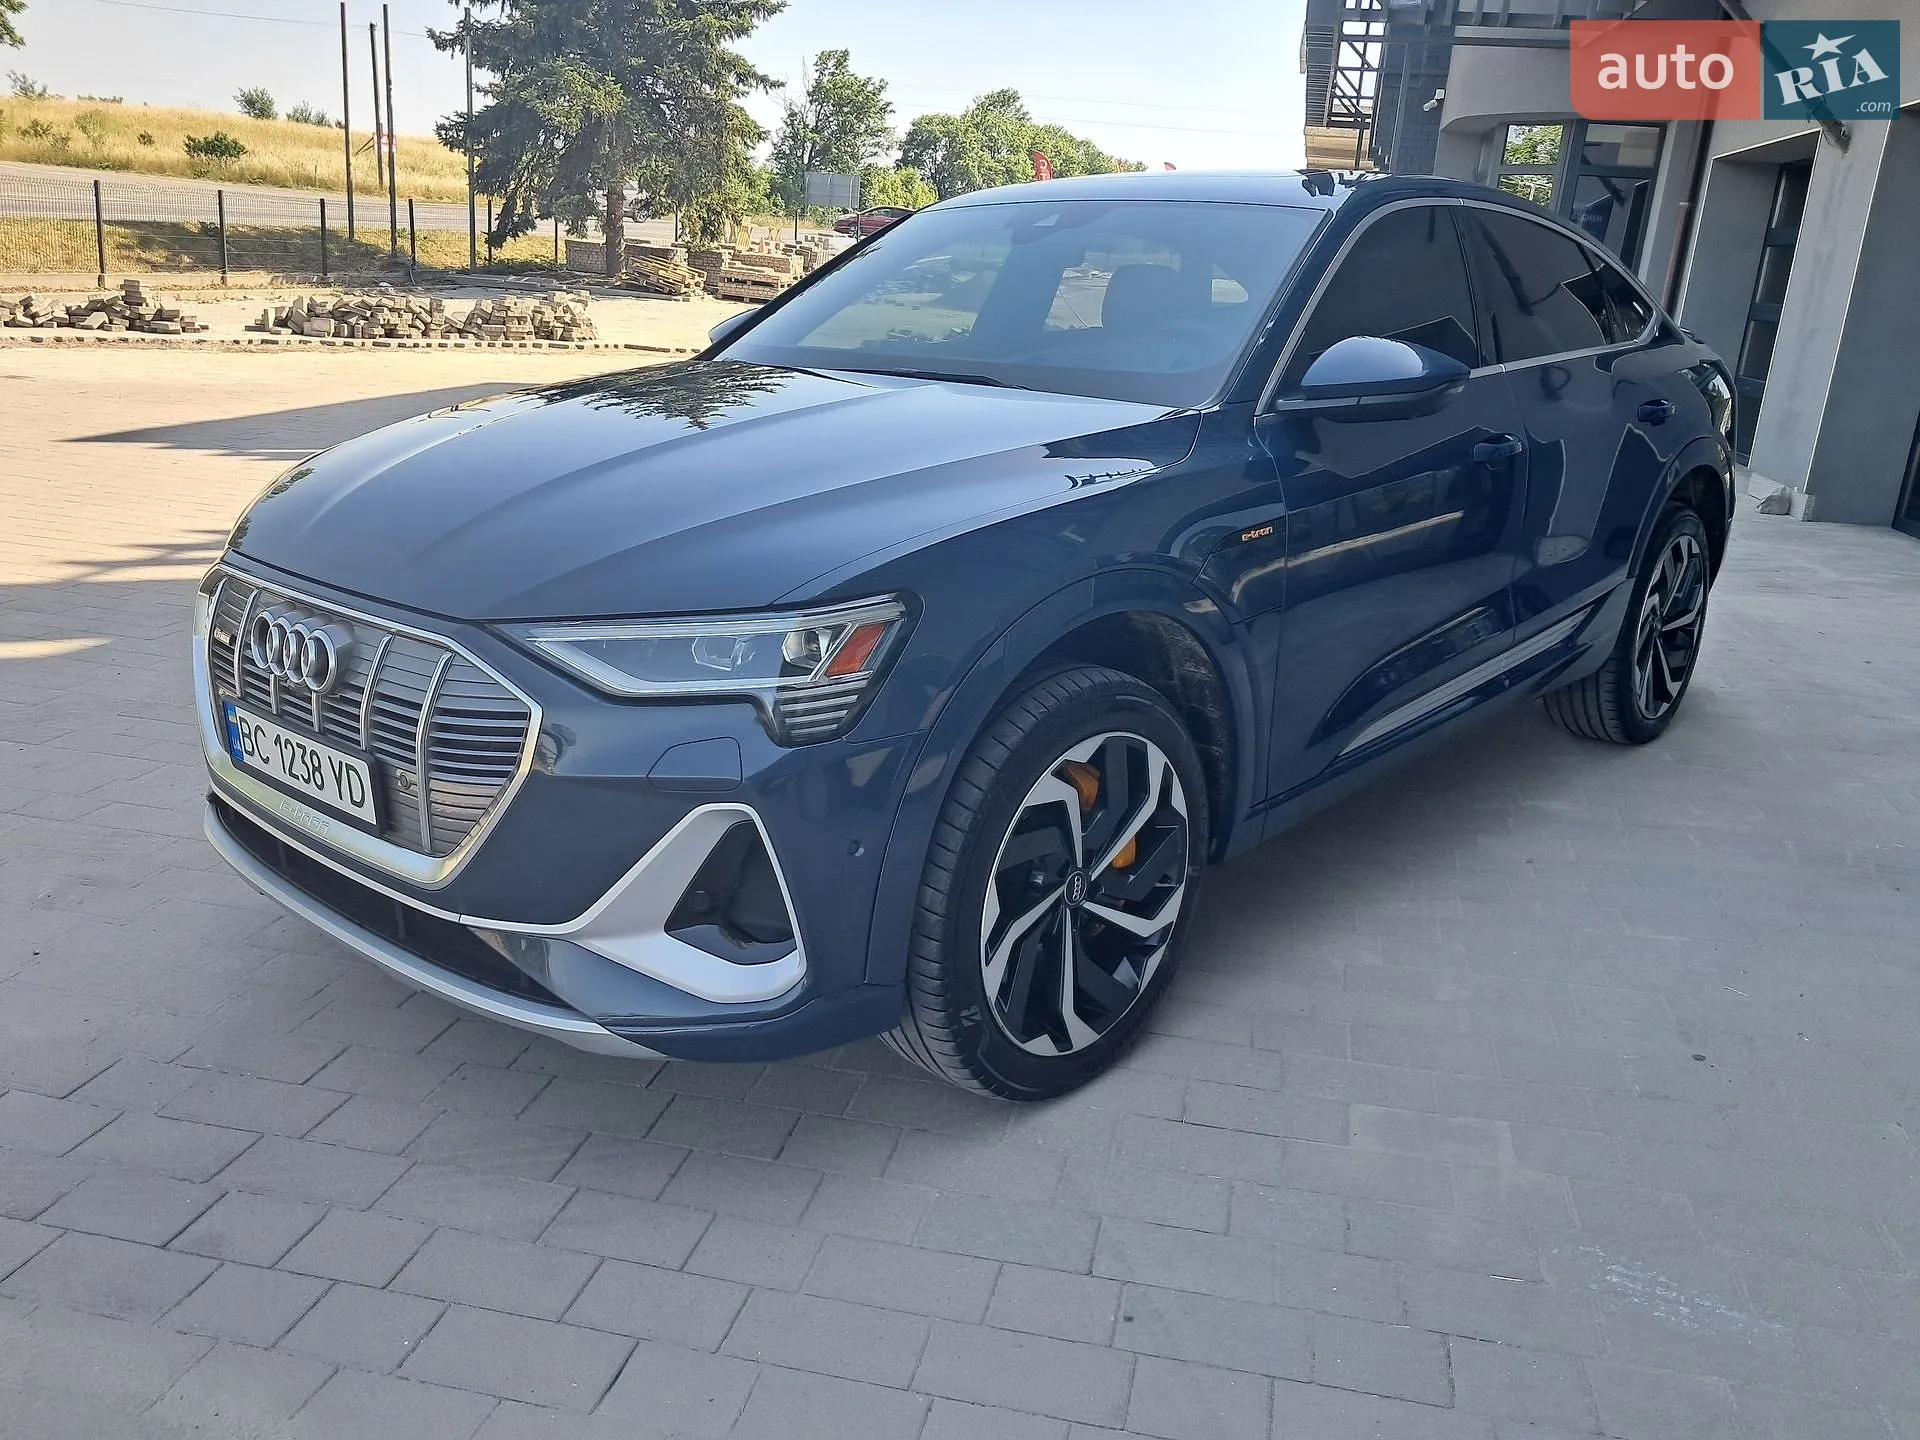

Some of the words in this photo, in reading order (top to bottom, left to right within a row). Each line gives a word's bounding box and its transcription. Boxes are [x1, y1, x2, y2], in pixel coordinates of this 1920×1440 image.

[1241, 526, 1273, 542] e-tron
[232, 737, 242, 751] UA
[238, 714, 270, 764] BC
[273, 734, 325, 791] 1238
[328, 755, 366, 809] YD
